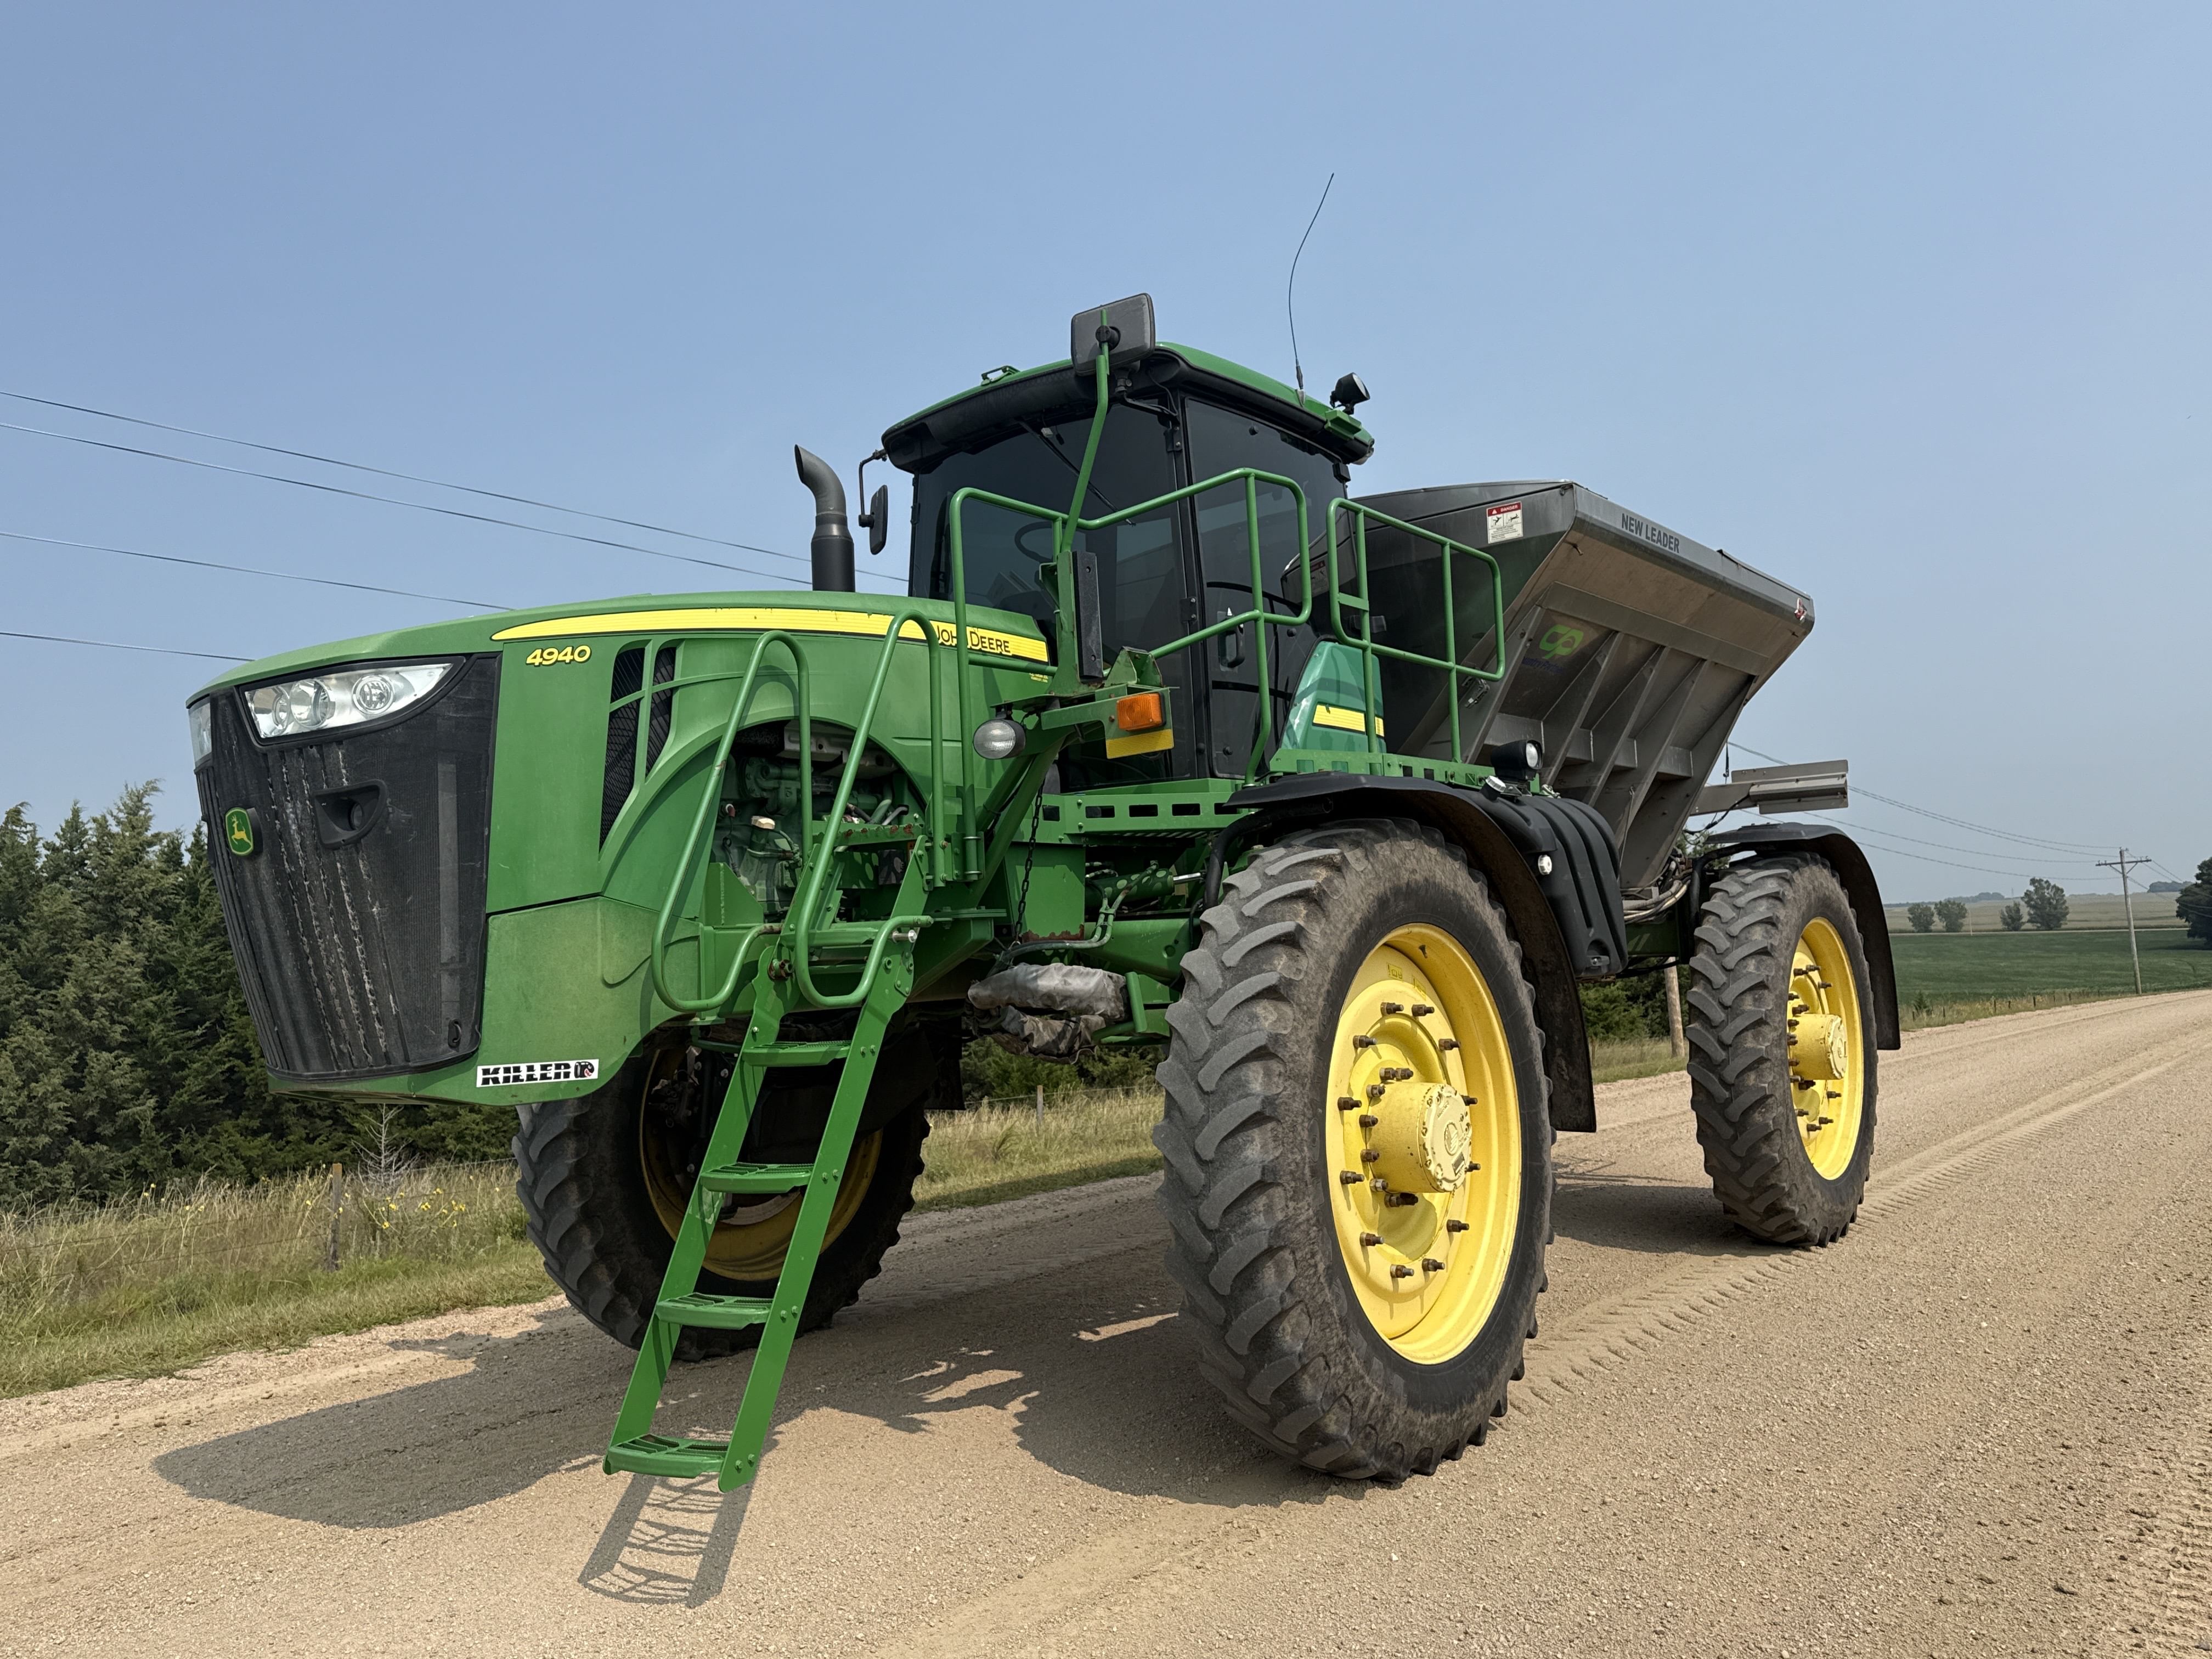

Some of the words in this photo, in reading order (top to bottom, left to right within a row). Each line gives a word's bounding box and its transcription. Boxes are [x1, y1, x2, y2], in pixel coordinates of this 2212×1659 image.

[1622, 513, 1643, 537] NEW
[1645, 524, 1679, 554] LEADER
[936, 625, 957, 644] JOH
[969, 631, 1011, 653] DEERE
[526, 645, 591, 666] 4940
[481, 1063, 571, 1085] KILLER
